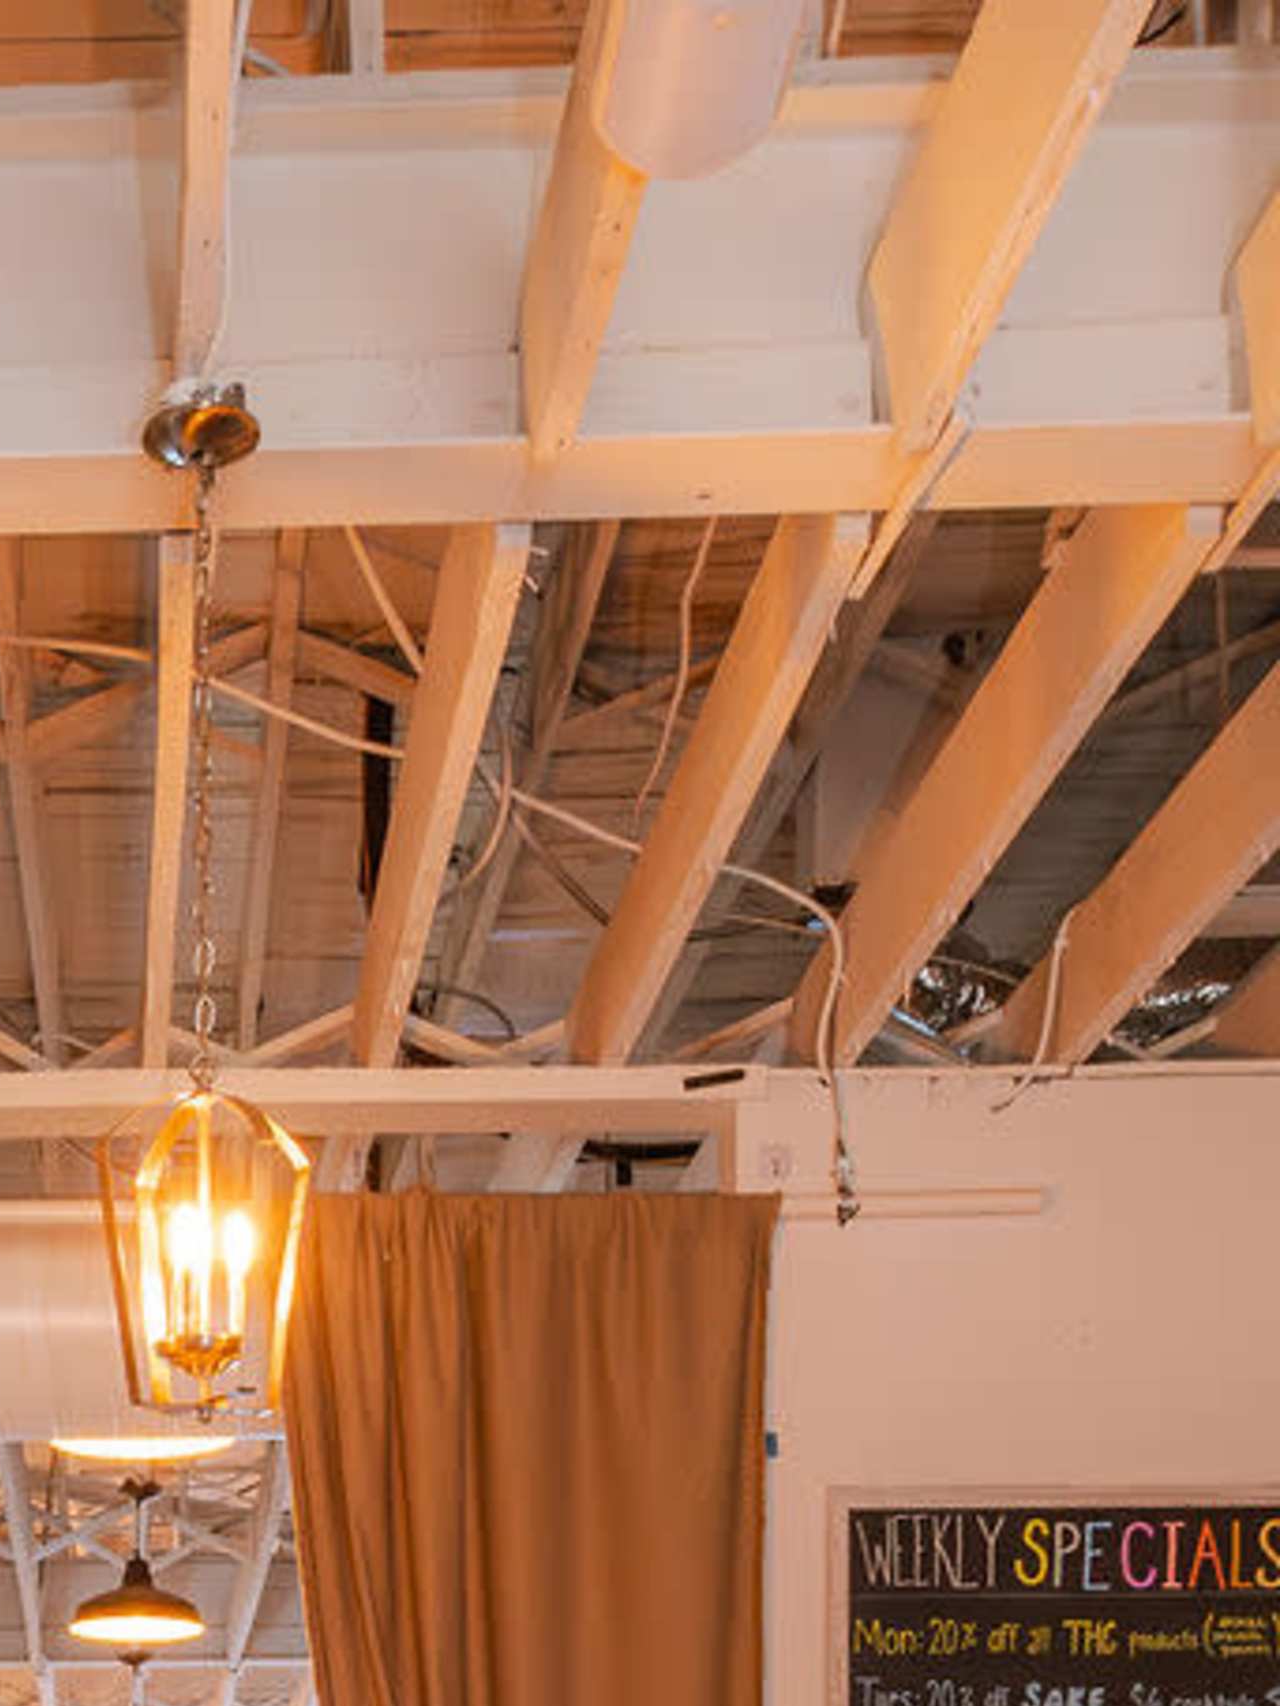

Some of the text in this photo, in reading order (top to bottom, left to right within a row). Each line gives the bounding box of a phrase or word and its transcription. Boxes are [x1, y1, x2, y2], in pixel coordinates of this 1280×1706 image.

[855, 1514, 1280, 1591] WEEKLY SPECIALS
[853, 1617, 923, 1656] Mon:
[927, 1617, 978, 1656] 20%
[1061, 1618, 1118, 1657] THC
